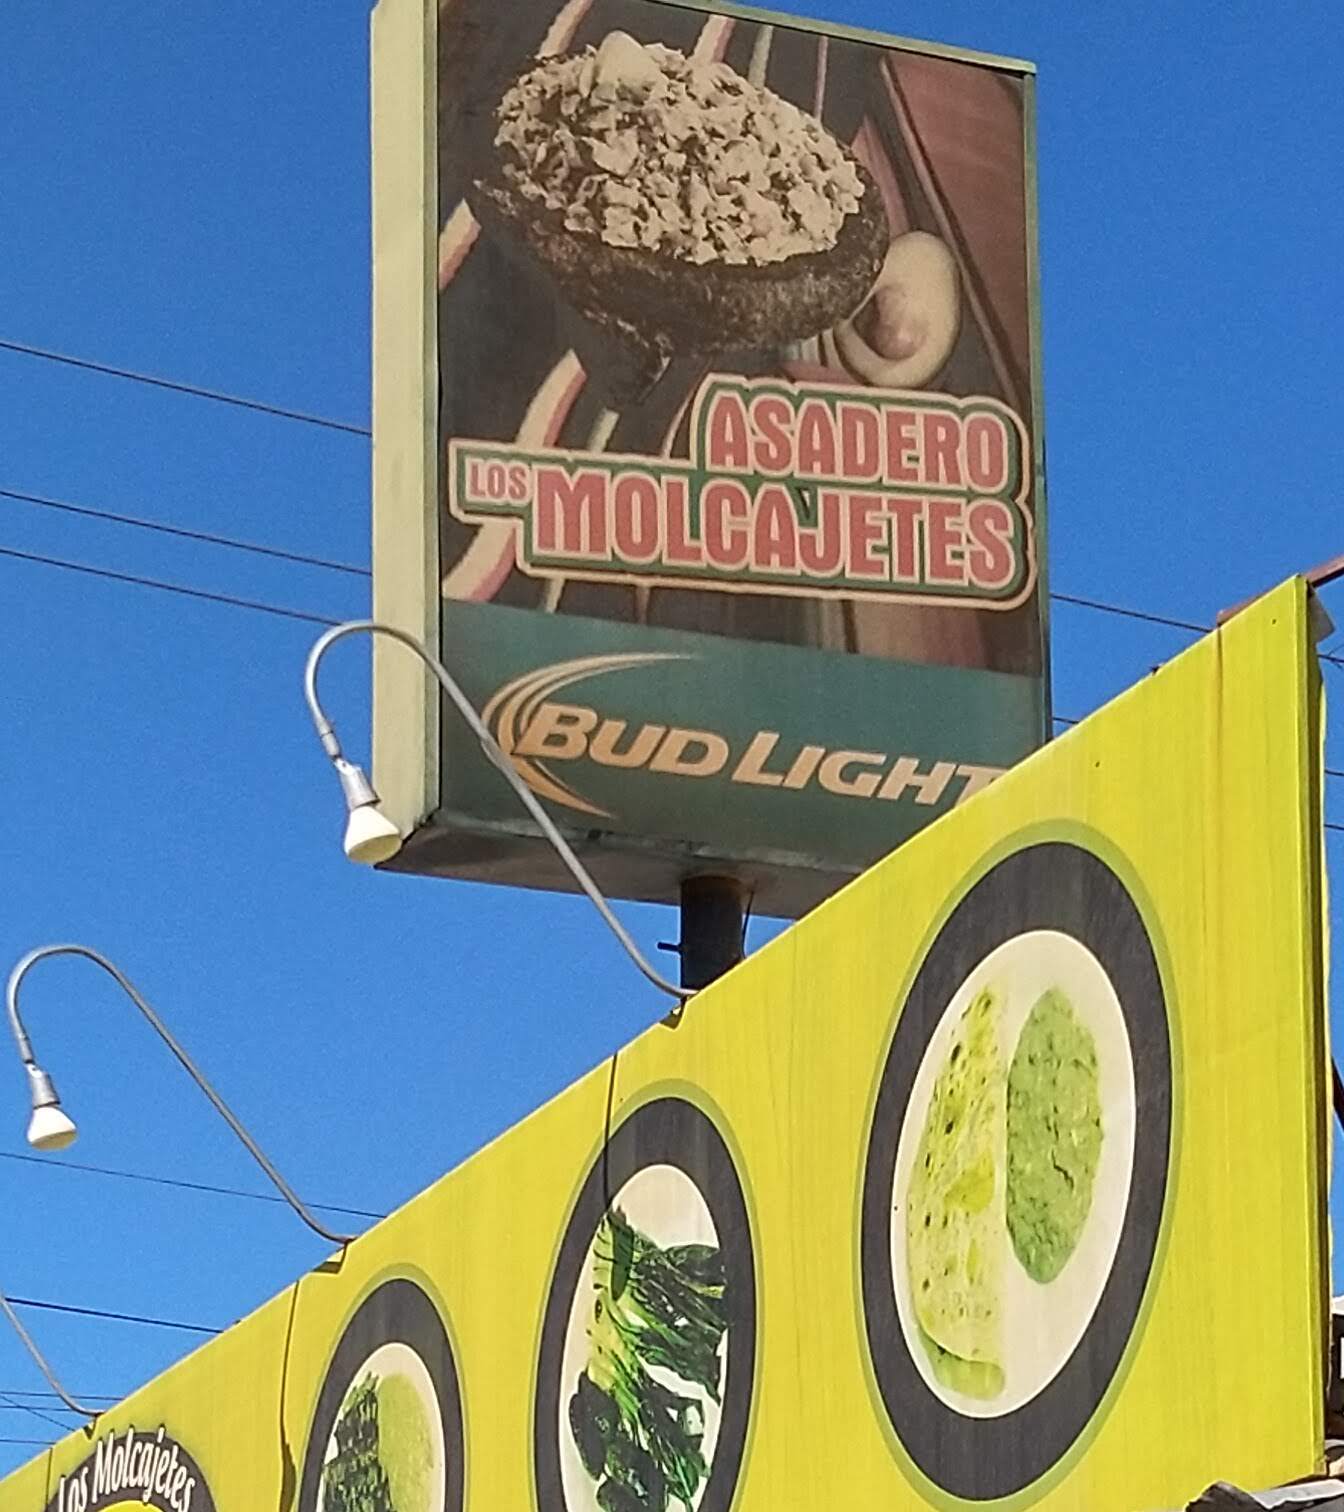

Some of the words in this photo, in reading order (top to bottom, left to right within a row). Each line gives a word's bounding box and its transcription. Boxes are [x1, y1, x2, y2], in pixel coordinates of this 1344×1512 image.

[708, 394, 1008, 490] ASADERO
[467, 459, 527, 501] LOS
[534, 465, 1014, 588] MOLCAJETES
[731, 731, 1010, 808] LIGHT
